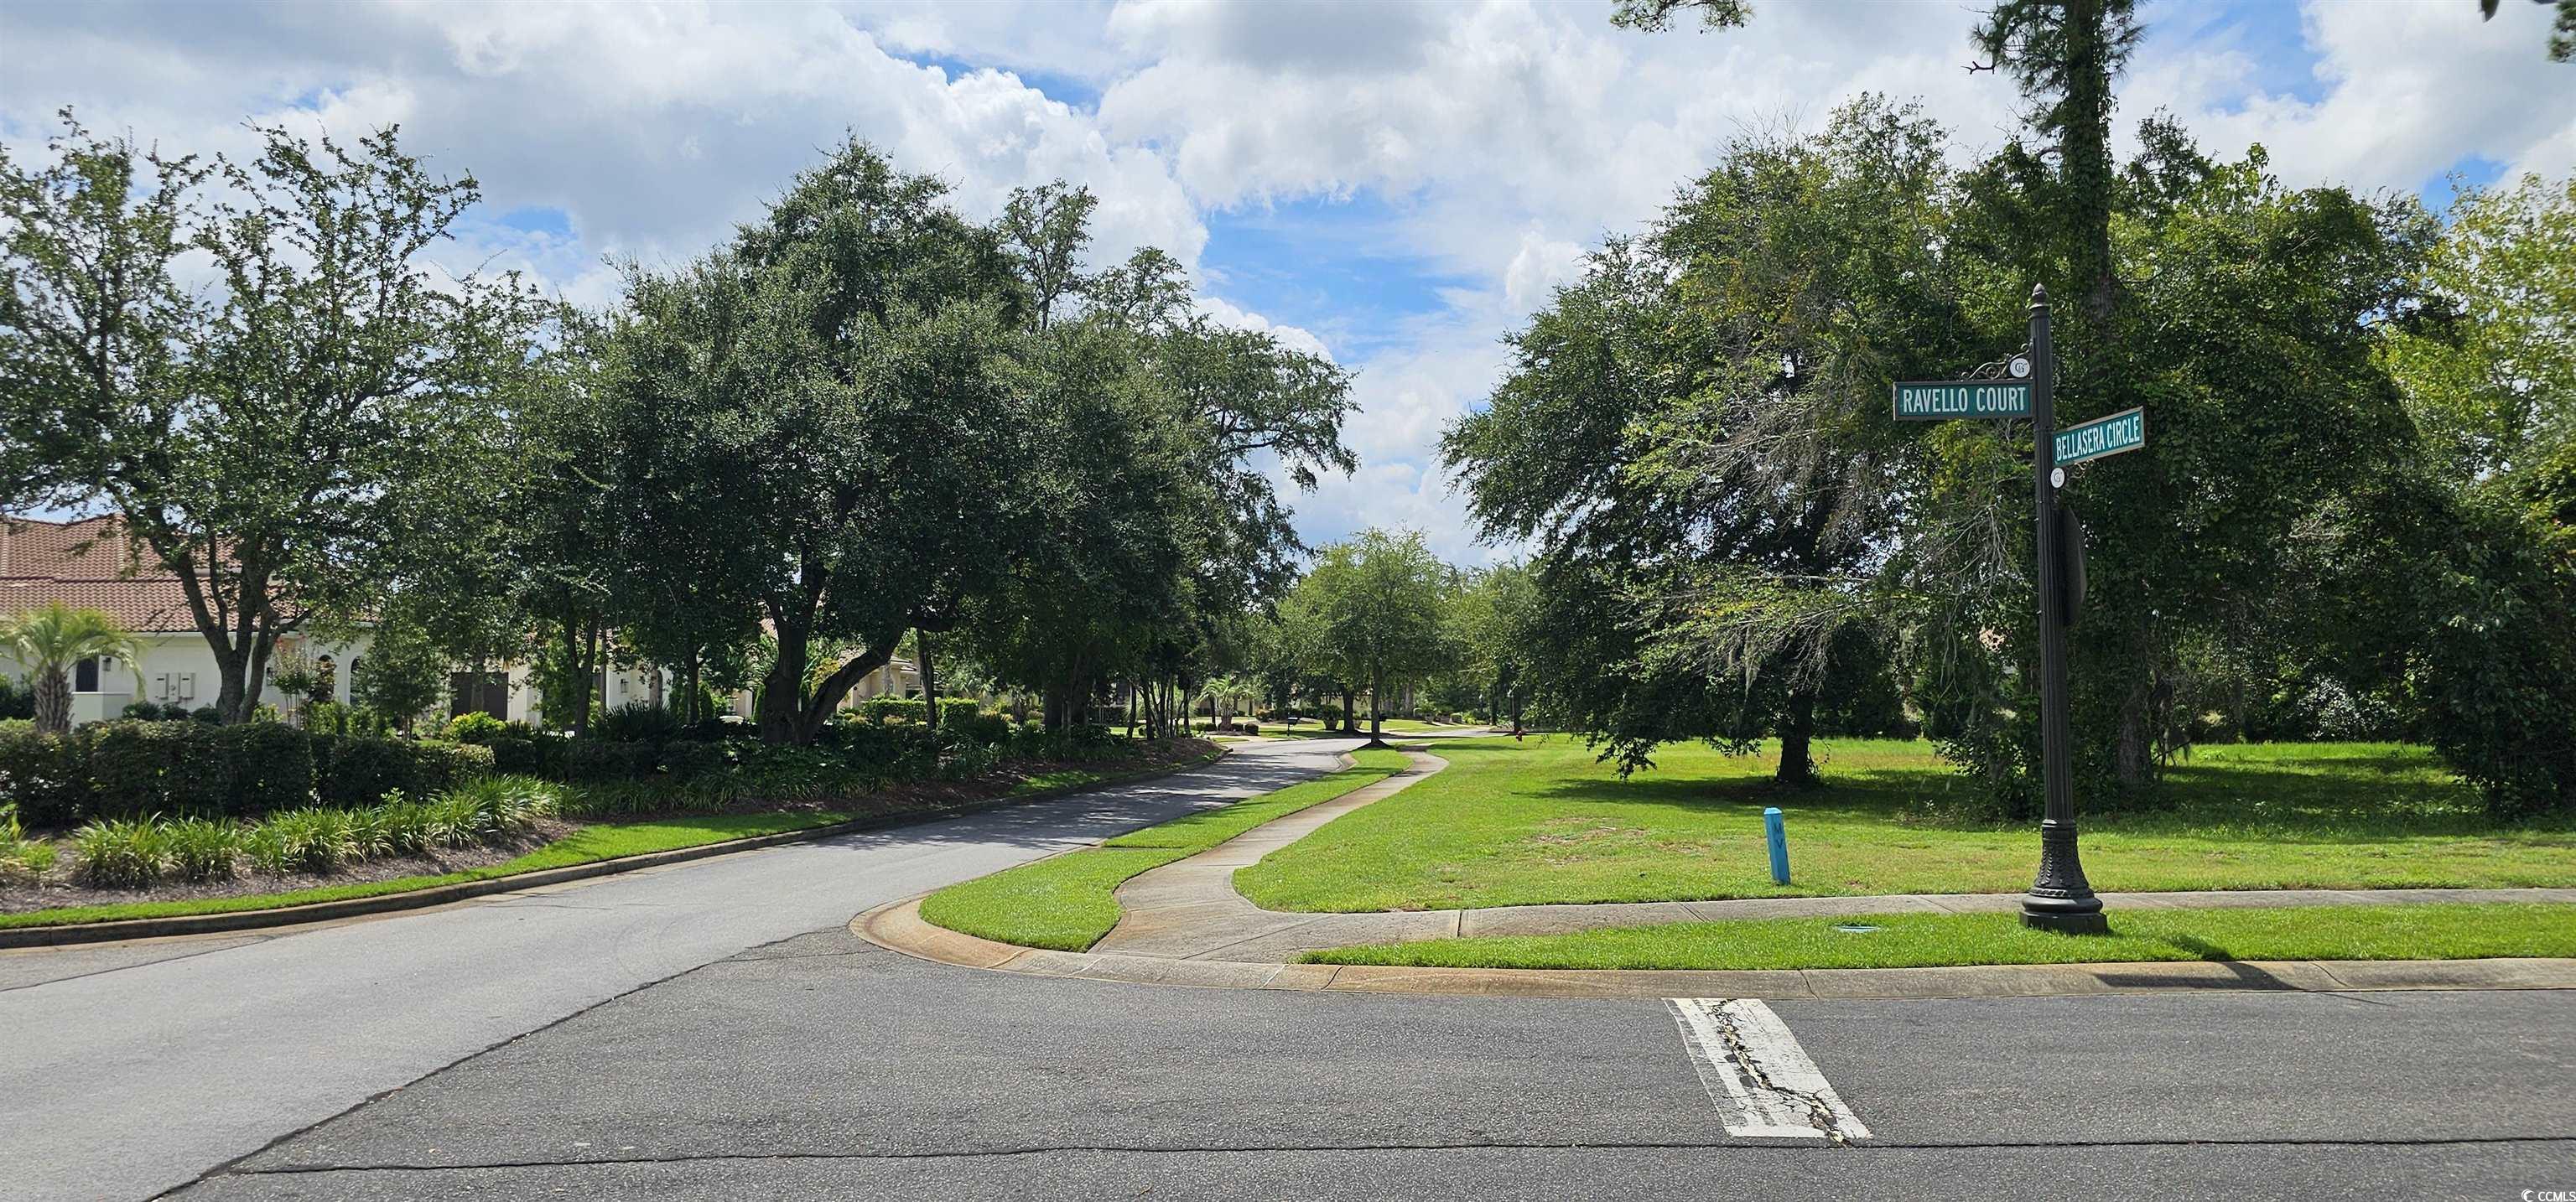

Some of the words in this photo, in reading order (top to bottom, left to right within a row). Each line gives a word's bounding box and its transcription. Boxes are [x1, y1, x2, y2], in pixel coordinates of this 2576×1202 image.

[1903, 387, 1968, 412] RAVELLO
[1976, 386, 2026, 412] COURT
[2055, 426, 2105, 462] BELLASERA
[2106, 415, 2140, 450] CIRCLE
